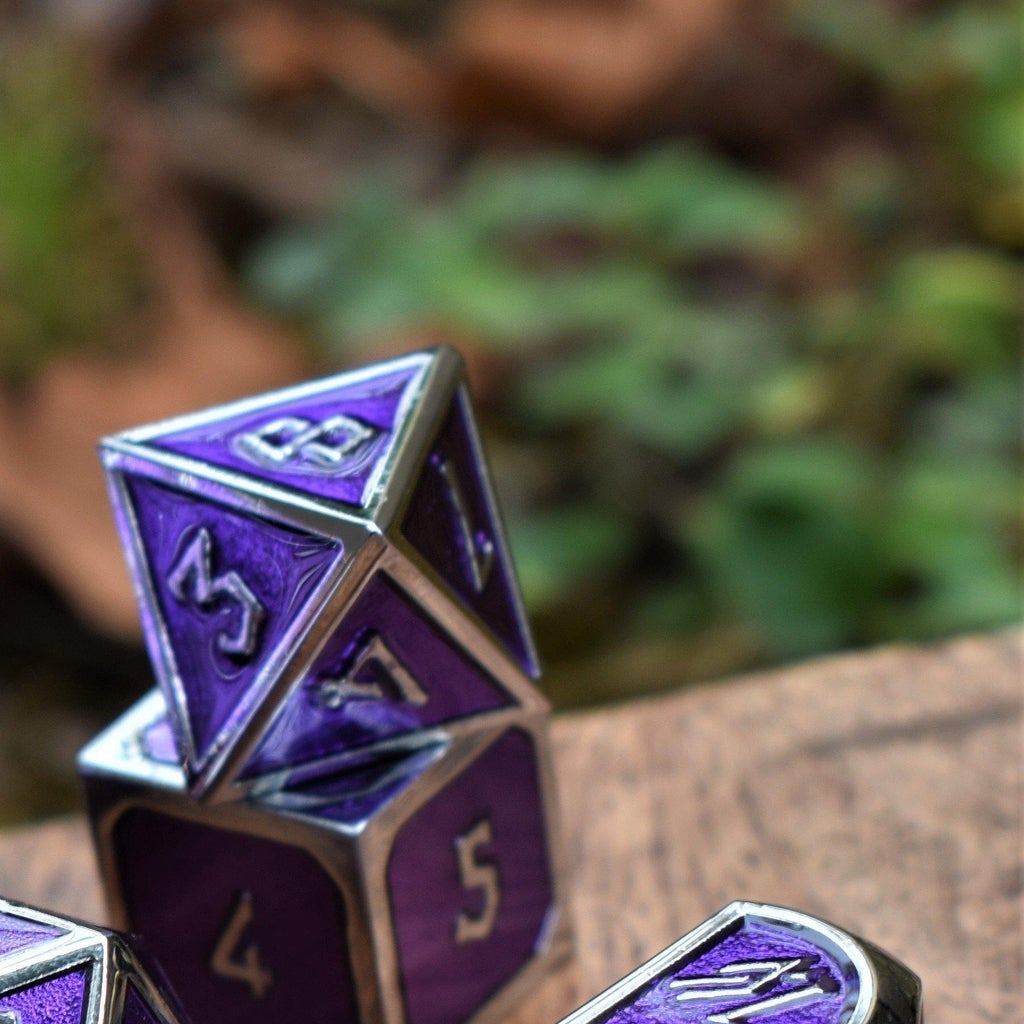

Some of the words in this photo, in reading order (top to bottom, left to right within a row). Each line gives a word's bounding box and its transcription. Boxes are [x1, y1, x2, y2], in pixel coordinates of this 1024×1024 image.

[239, 414, 374, 463] 8
[167, 526, 268, 660] 3
[454, 817, 501, 946] 5
[209, 889, 274, 1000] 4
